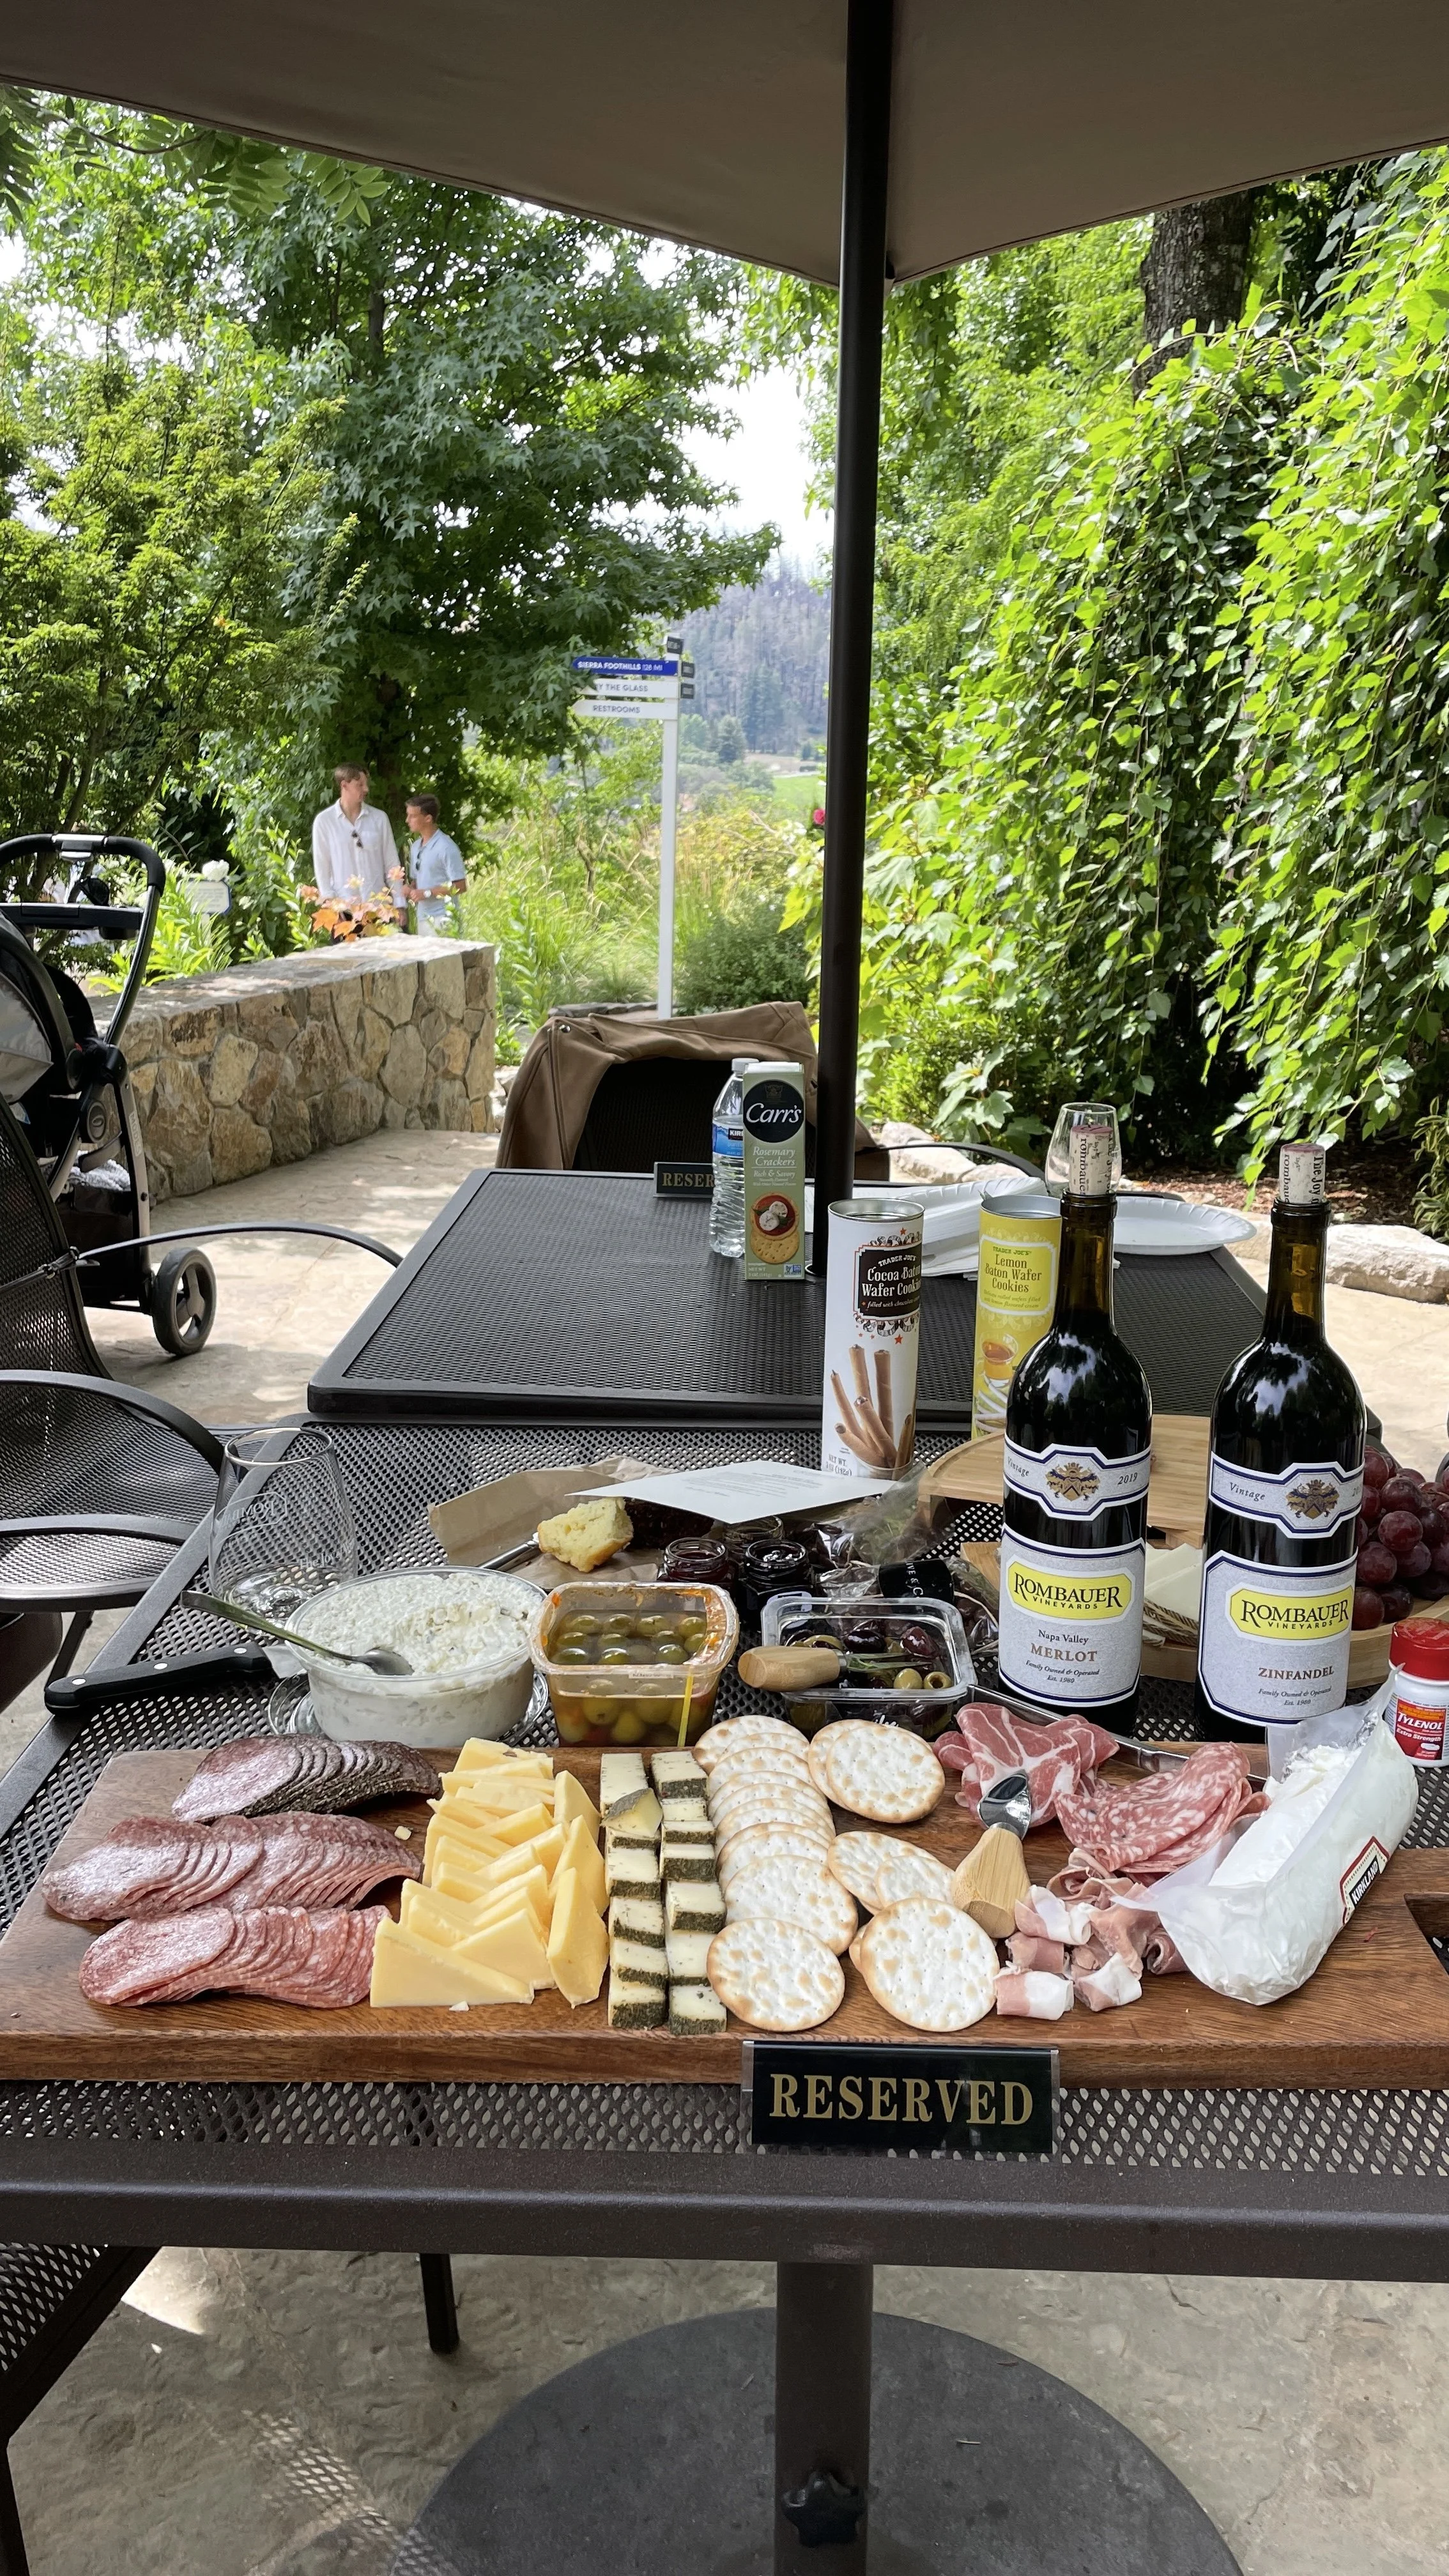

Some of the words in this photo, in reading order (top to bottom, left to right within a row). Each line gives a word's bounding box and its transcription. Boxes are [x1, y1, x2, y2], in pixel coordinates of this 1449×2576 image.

[603, 662, 641, 670] FOOTHILLS
[593, 705, 641, 714] RESTROOMS
[746, 1103, 802, 1123] Carr's
[753, 1146, 795, 1158] Rosemary
[755, 1156, 795, 1166] Crackers
[1314, 1154, 1324, 1176] The
[662, 1172, 715, 1187] RESER
[1309, 1177, 1322, 1195] Joy
[878, 1255, 903, 1266] TRADER
[995, 1254, 1027, 1268] Lemon
[868, 1266, 900, 1282] Cocoa
[985, 1262, 1008, 1278] Baton
[1011, 1268, 1042, 1281] Wafer
[861, 1282, 895, 1296] Wafer
[992, 1277, 1029, 1292] Cookies
[1008, 1456, 1029, 1477] Vintage
[1117, 1471, 1138, 1487] 2019
[1230, 1482, 1266, 1501] Vintage
[1013, 1572, 1123, 1609] ROMBAUER
[1033, 1595, 1098, 1610] VINEYARDS
[1241, 1598, 1349, 1628] ROMBAUER
[1268, 1620, 1333, 1630] VINEYARDS
[1038, 1629, 1061, 1643] Napa
[1061, 1632, 1089, 1646] Valley
[1031, 1643, 1098, 1662] MERLOT
[1025, 1660, 1043, 1671] Family
[1044, 1666, 1065, 1675] Owned
[1074, 1668, 1100, 1677] Operated
[1258, 1666, 1334, 1680] ZINFANDEL
[1258, 1688, 1279, 1698] Family
[1397, 1711, 1444, 1730] TYLENOL
[1396, 1728, 1412, 1737] Extra
[1413, 1733, 1442, 1742] Strength
[1351, 1860, 1379, 1905] KIRKLAND
[769, 2073, 1034, 2126] RESERVED
